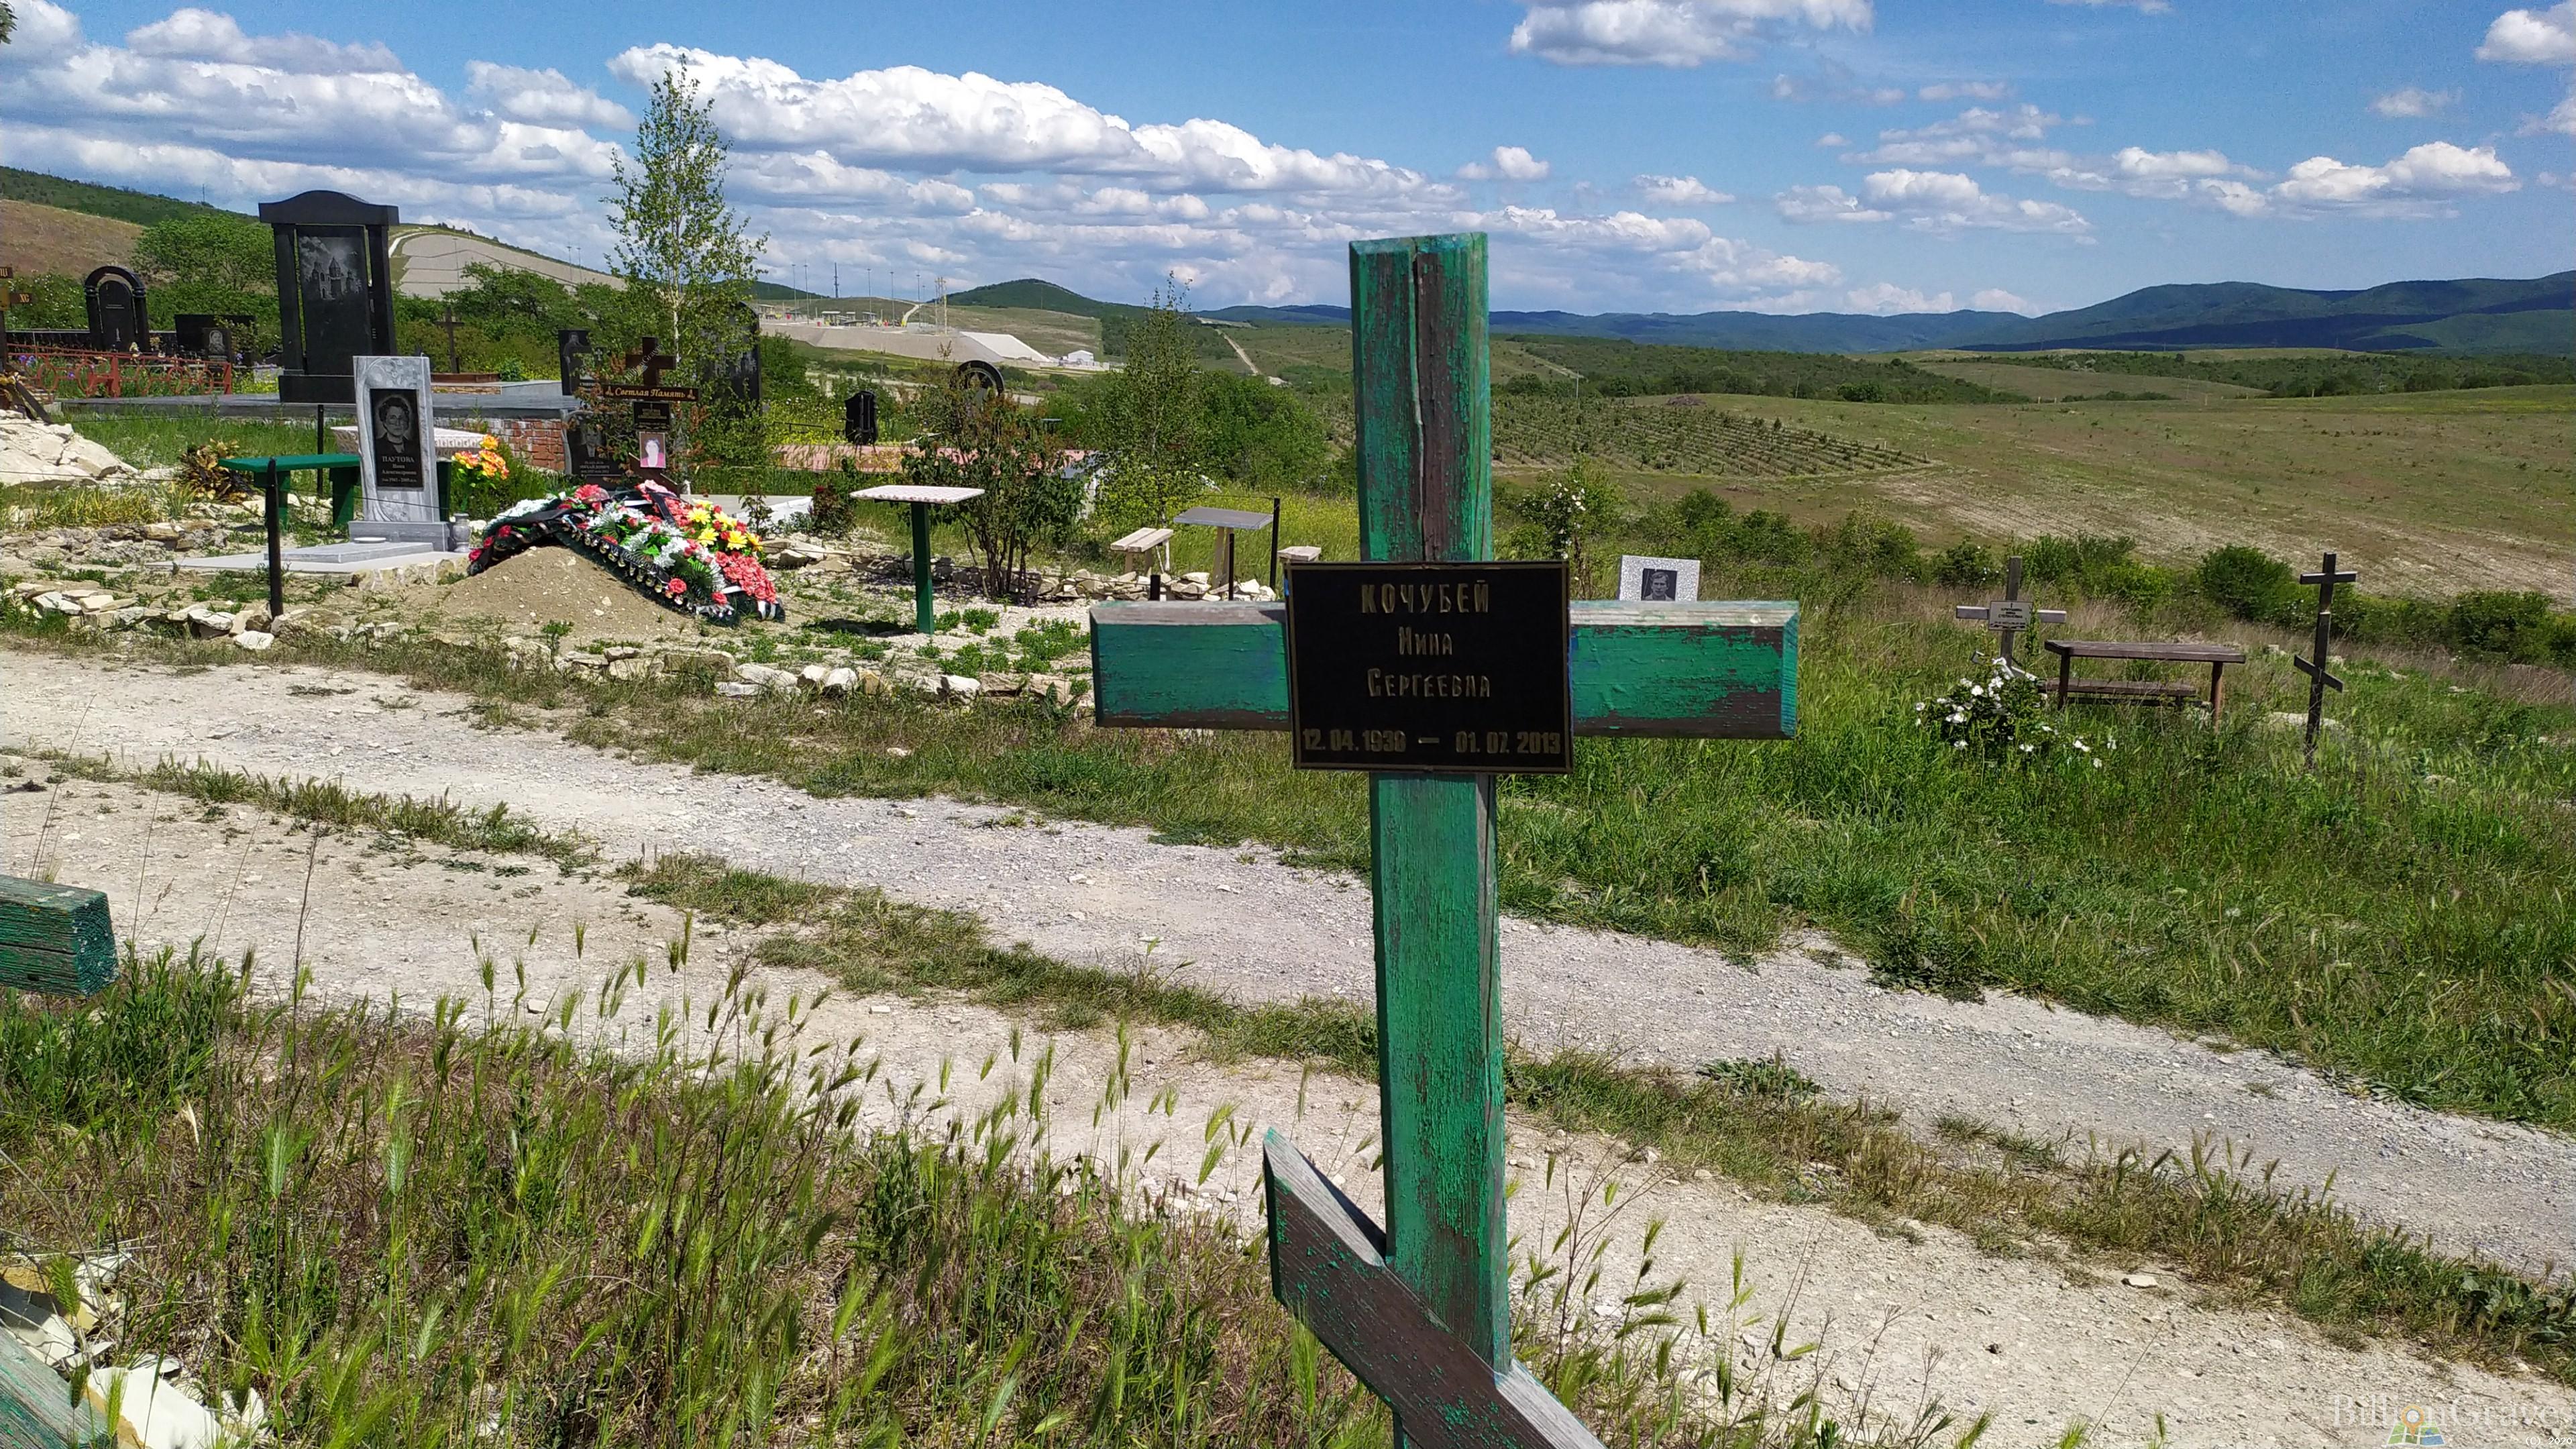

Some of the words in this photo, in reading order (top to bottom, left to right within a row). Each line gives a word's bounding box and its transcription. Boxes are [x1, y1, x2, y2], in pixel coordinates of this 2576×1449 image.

[614, 387, 649, 396] Светлая
[650, 389, 686, 398] Память
[1360, 579, 1489, 614] КОЧУБЕЙ
